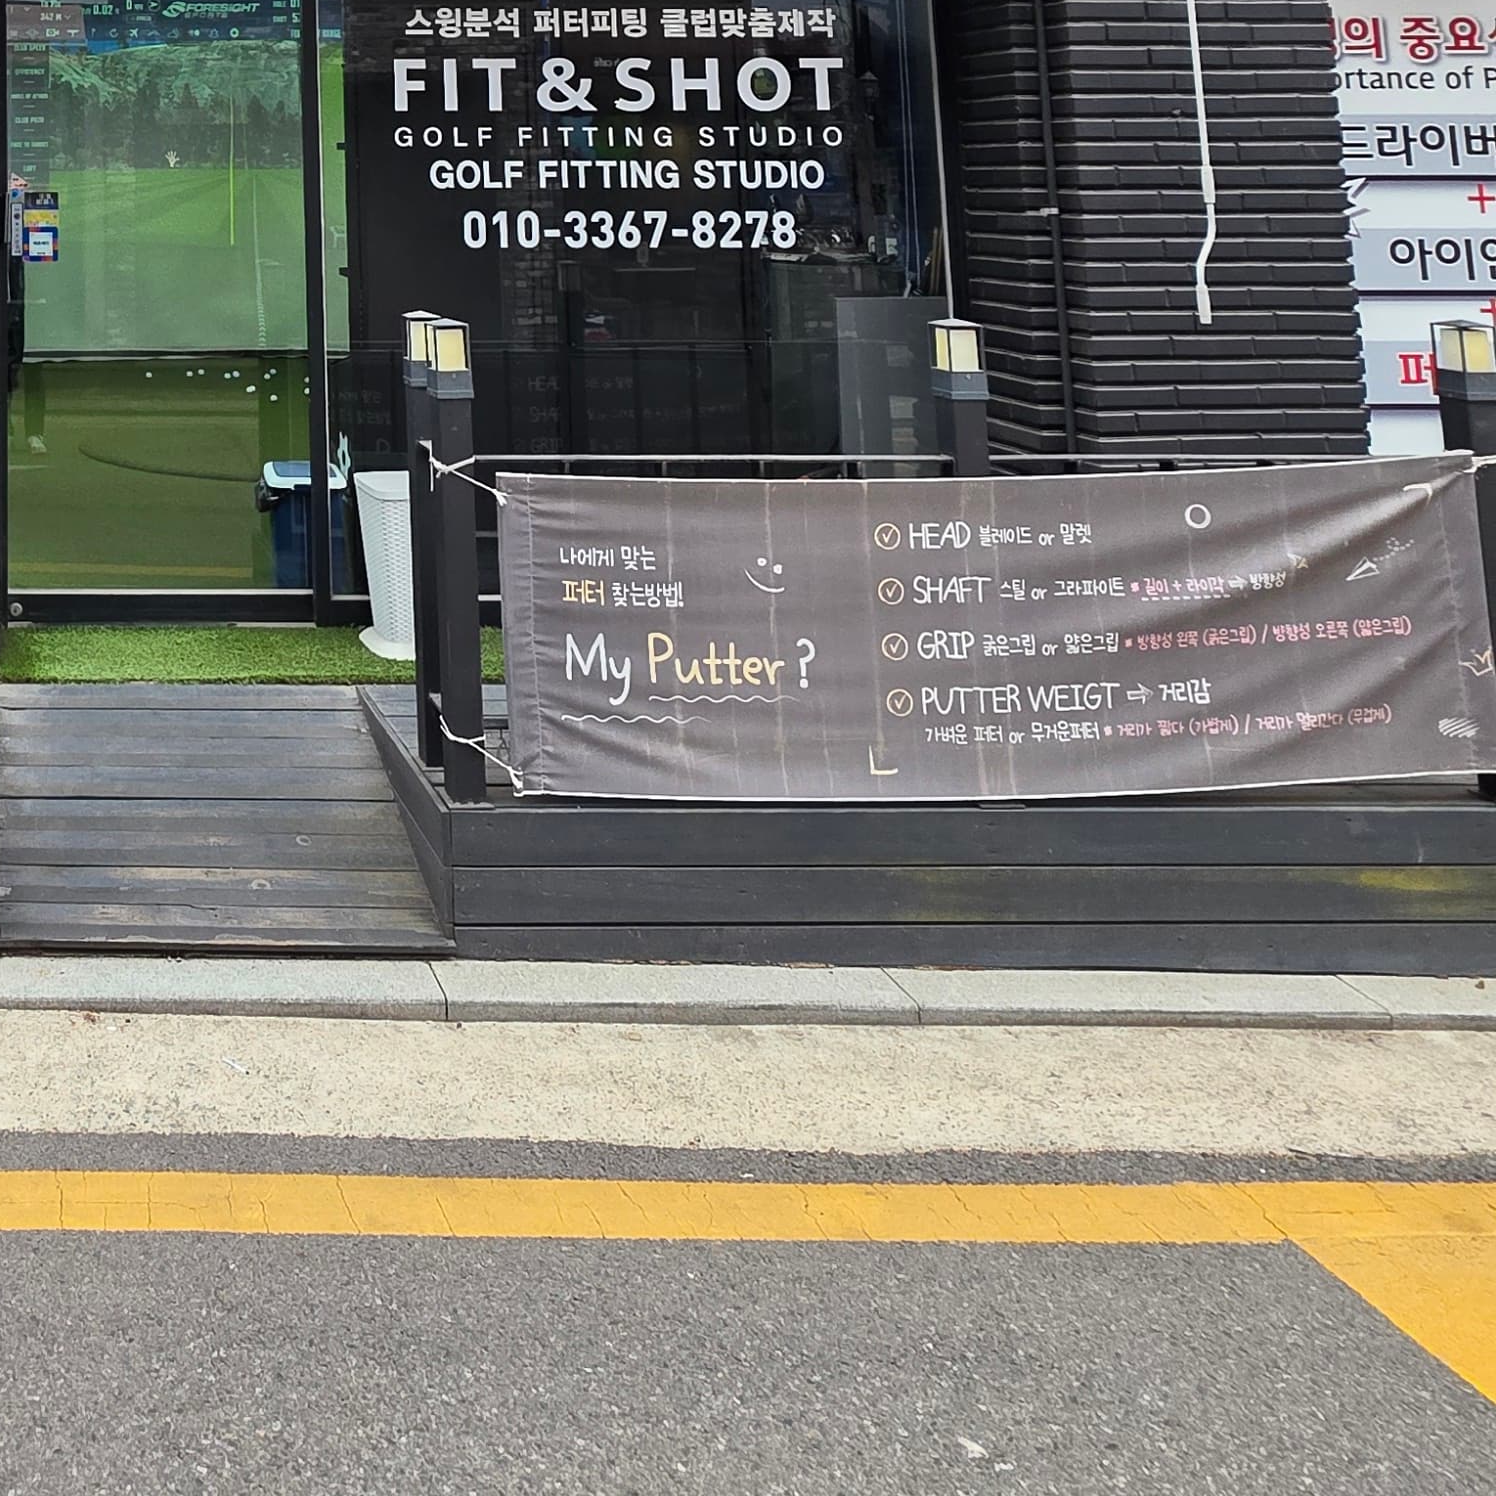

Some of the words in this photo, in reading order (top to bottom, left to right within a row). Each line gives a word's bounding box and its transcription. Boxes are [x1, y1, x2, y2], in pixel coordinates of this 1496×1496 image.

[185, 3, 260, 12] FORESIGHT
[404, 7, 520, 38] 스윙분석
[533, 7, 647, 39] 퍼터피팅
[660, 6, 837, 38] 클럽맞춤제작
[1328, 17, 1384, 59] 의
[1400, 17, 1496, 59] 중요
[1445, 66, 1474, 89] of
[394, 126, 493, 147] GOLF
[518, 126, 673, 147] FITTING
[698, 125, 844, 147] STUDIO
[429, 160, 524, 190] GOLF
[538, 160, 680, 190] FITTING
[693, 160, 825, 190] STUDIO
[463, 210, 797, 249] 010-3367-8278
[909, 521, 971, 549] HEAD
[979, 526, 1032, 547] 블레이드
[1038, 533, 1055, 546] or
[1060, 523, 1092, 544] 말렛
[560, 547, 615, 567] 나에게
[621, 546, 657, 571] 맞는
[562, 580, 605, 605] 퍼터
[913, 576, 992, 604] SHAFT
[1000, 579, 1026, 601] 스틸
[1031, 586, 1048, 600] or
[1054, 577, 1126, 597] 그라파이트
[1144, 577, 1169, 597] 길이
[1250, 571, 1286, 590] 방향성
[917, 630, 975, 660] GRIP
[983, 634, 1036, 656] 굵은그립
[1042, 642, 1058, 656] or
[1064, 632, 1119, 654] 얇은그립
[1137, 633, 1172, 651] 방향성
[1272, 622, 1311, 642] 방향성
[1315, 621, 1348, 639] 오른쪽
[566, 633, 631, 705] My
[921, 684, 1022, 716] PUTTER
[1027, 682, 1120, 712] WEIGT
[1158, 678, 1211, 704] 거리감
[925, 724, 967, 745] 가벼운
[974, 725, 1003, 743] 퍼터
[1009, 732, 1025, 744] or
[1031, 721, 1100, 742] 무거운퍼터
